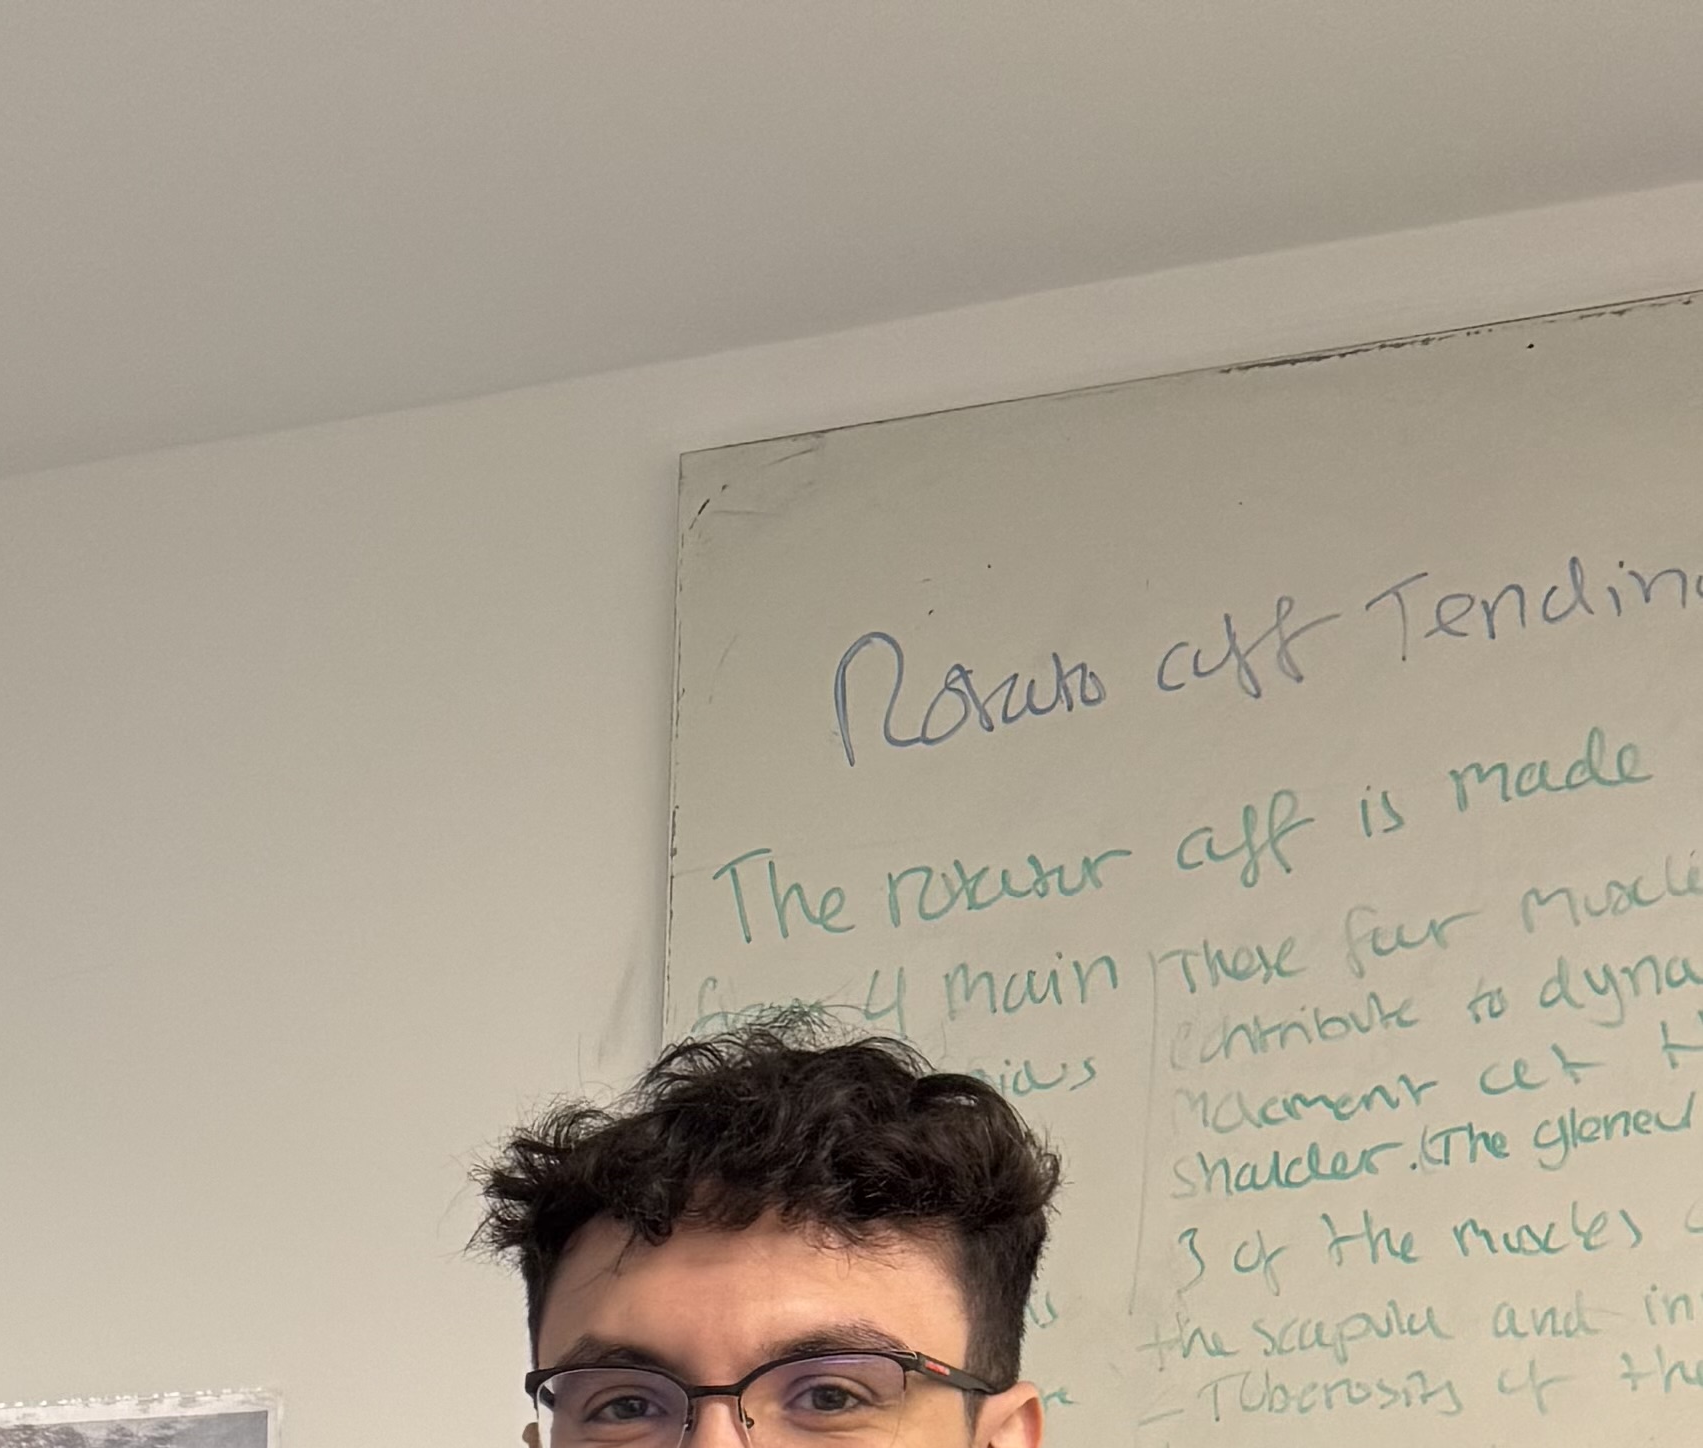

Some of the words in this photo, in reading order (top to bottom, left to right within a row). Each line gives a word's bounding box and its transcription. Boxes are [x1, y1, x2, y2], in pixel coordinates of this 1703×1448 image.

[1364, 555, 1703, 662] Tendin
[711, 847, 857, 944] The
[1359, 785, 1406, 838] is
[1448, 726, 1655, 812] made
[942, 950, 1120, 1022] main
[1320, 1209, 1421, 1267] the
